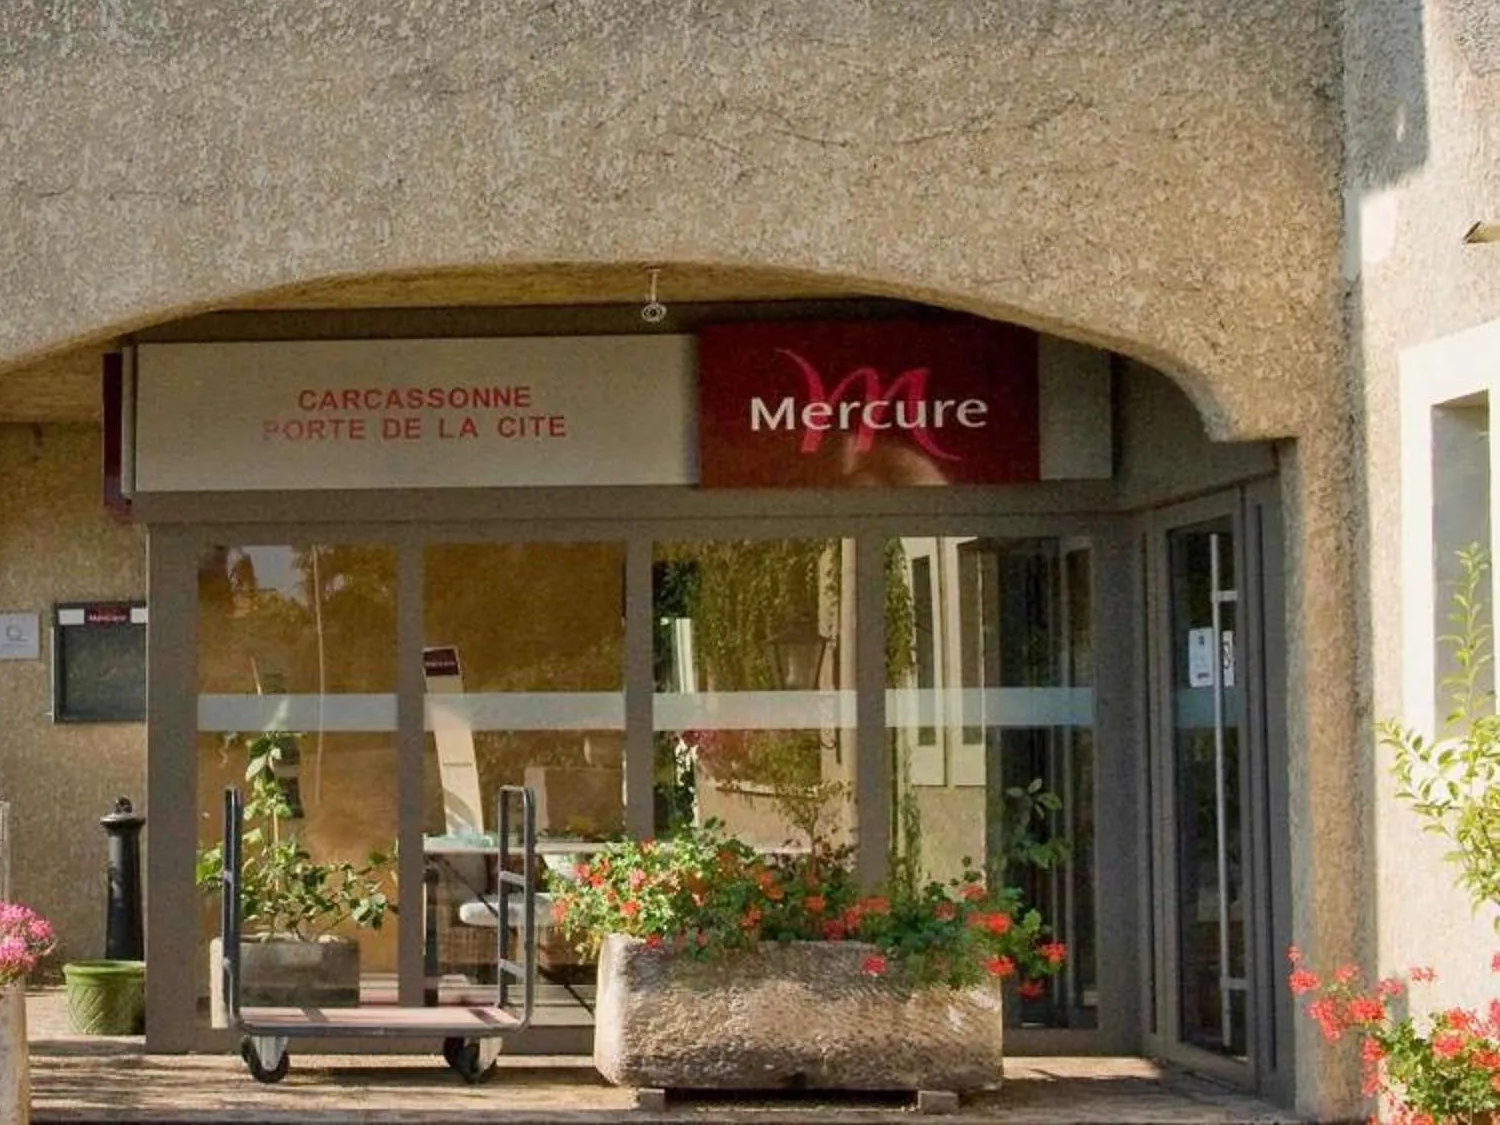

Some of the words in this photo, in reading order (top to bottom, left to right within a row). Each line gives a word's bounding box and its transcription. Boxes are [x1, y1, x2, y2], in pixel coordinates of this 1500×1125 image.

[297, 386, 532, 412] CARCASSONNE
[751, 395, 989, 431] Mercure
[262, 418, 366, 441] PORTE
[381, 418, 422, 440] DE
[438, 417, 479, 439] LA
[497, 415, 567, 437] CITE
